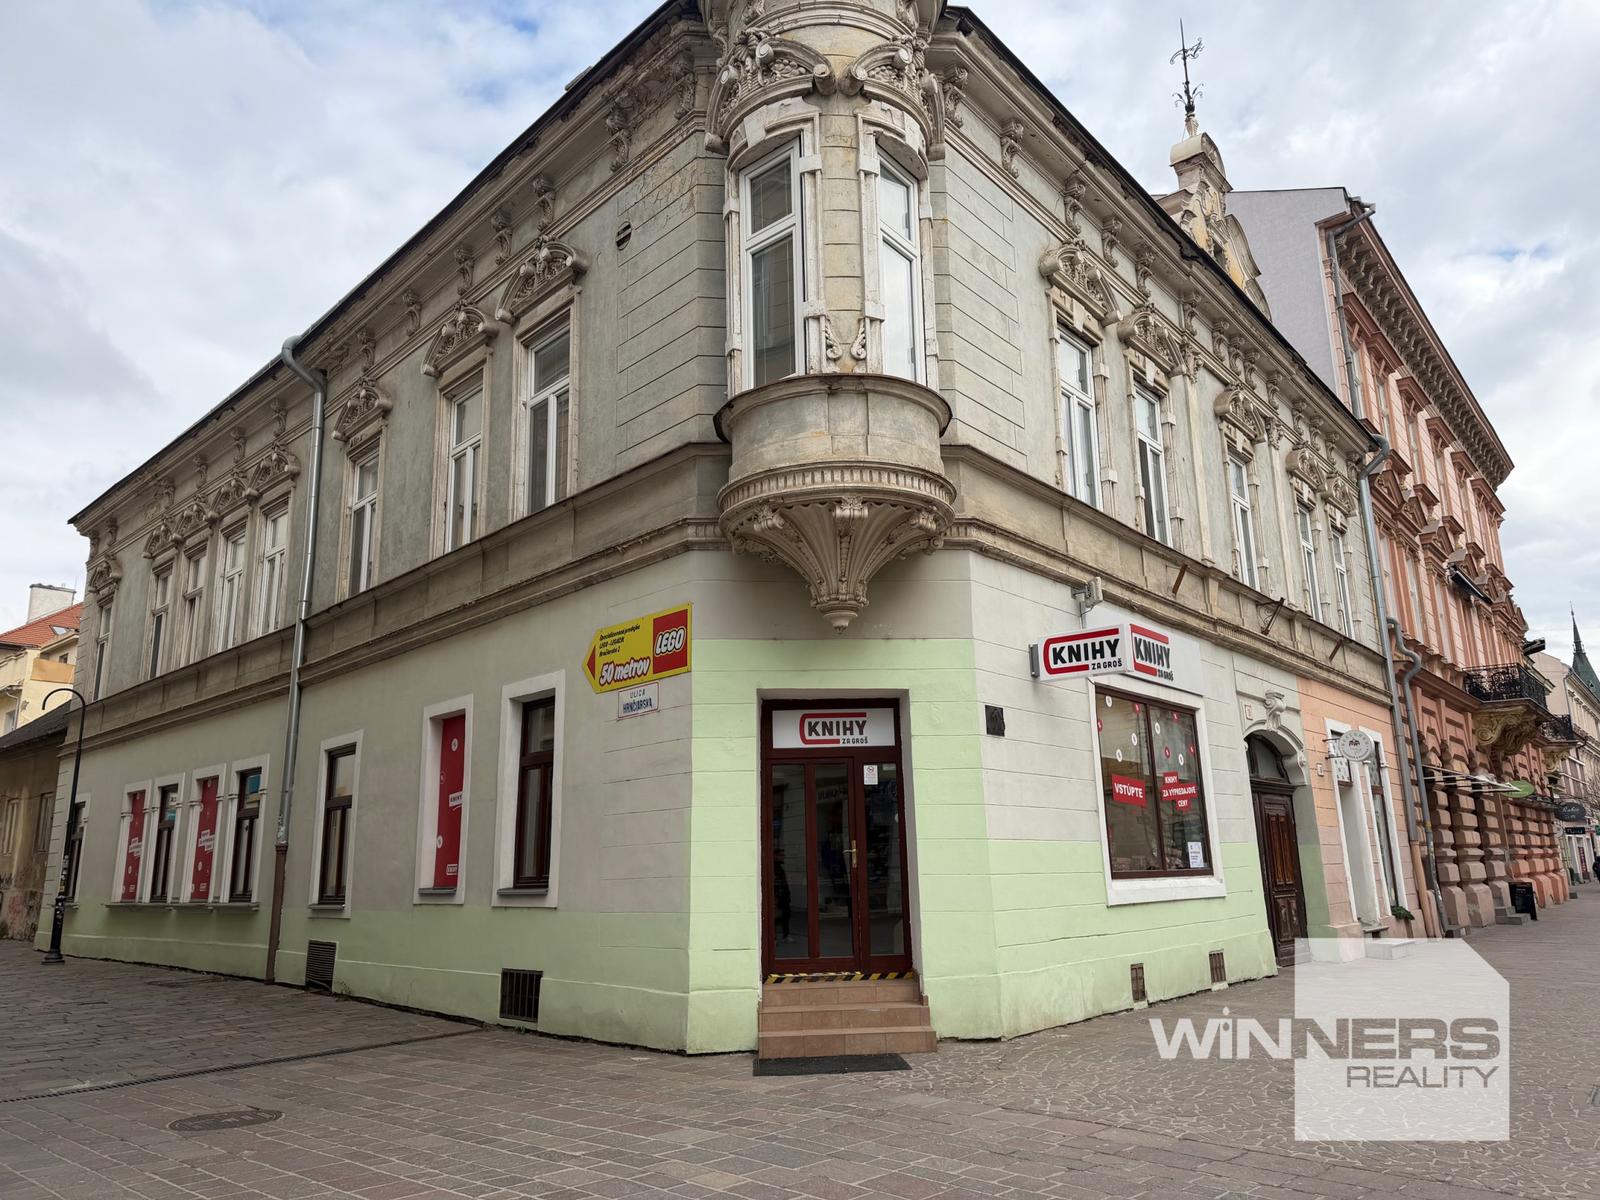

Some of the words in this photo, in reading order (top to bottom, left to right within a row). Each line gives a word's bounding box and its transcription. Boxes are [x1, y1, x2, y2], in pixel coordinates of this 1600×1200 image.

[655, 627, 686, 656] LEGO
[1052, 638, 1120, 665] KNIHY
[1134, 636, 1171, 669] KNIHY
[599, 661, 615, 686] 50
[614, 656, 651, 682] metrov
[1091, 662, 1102, 670] ZA
[1102, 658, 1123, 669] GROŠ
[1157, 669, 1164, 678] ZA
[1163, 671, 1174, 682] GROŠ
[630, 688, 646, 699] ULICA
[808, 719, 868, 737] KNIHY
[851, 736, 869, 744] GROŠ
[1114, 782, 1144, 798] VSTÚPTE
[1162, 789, 1169, 798] ZA
